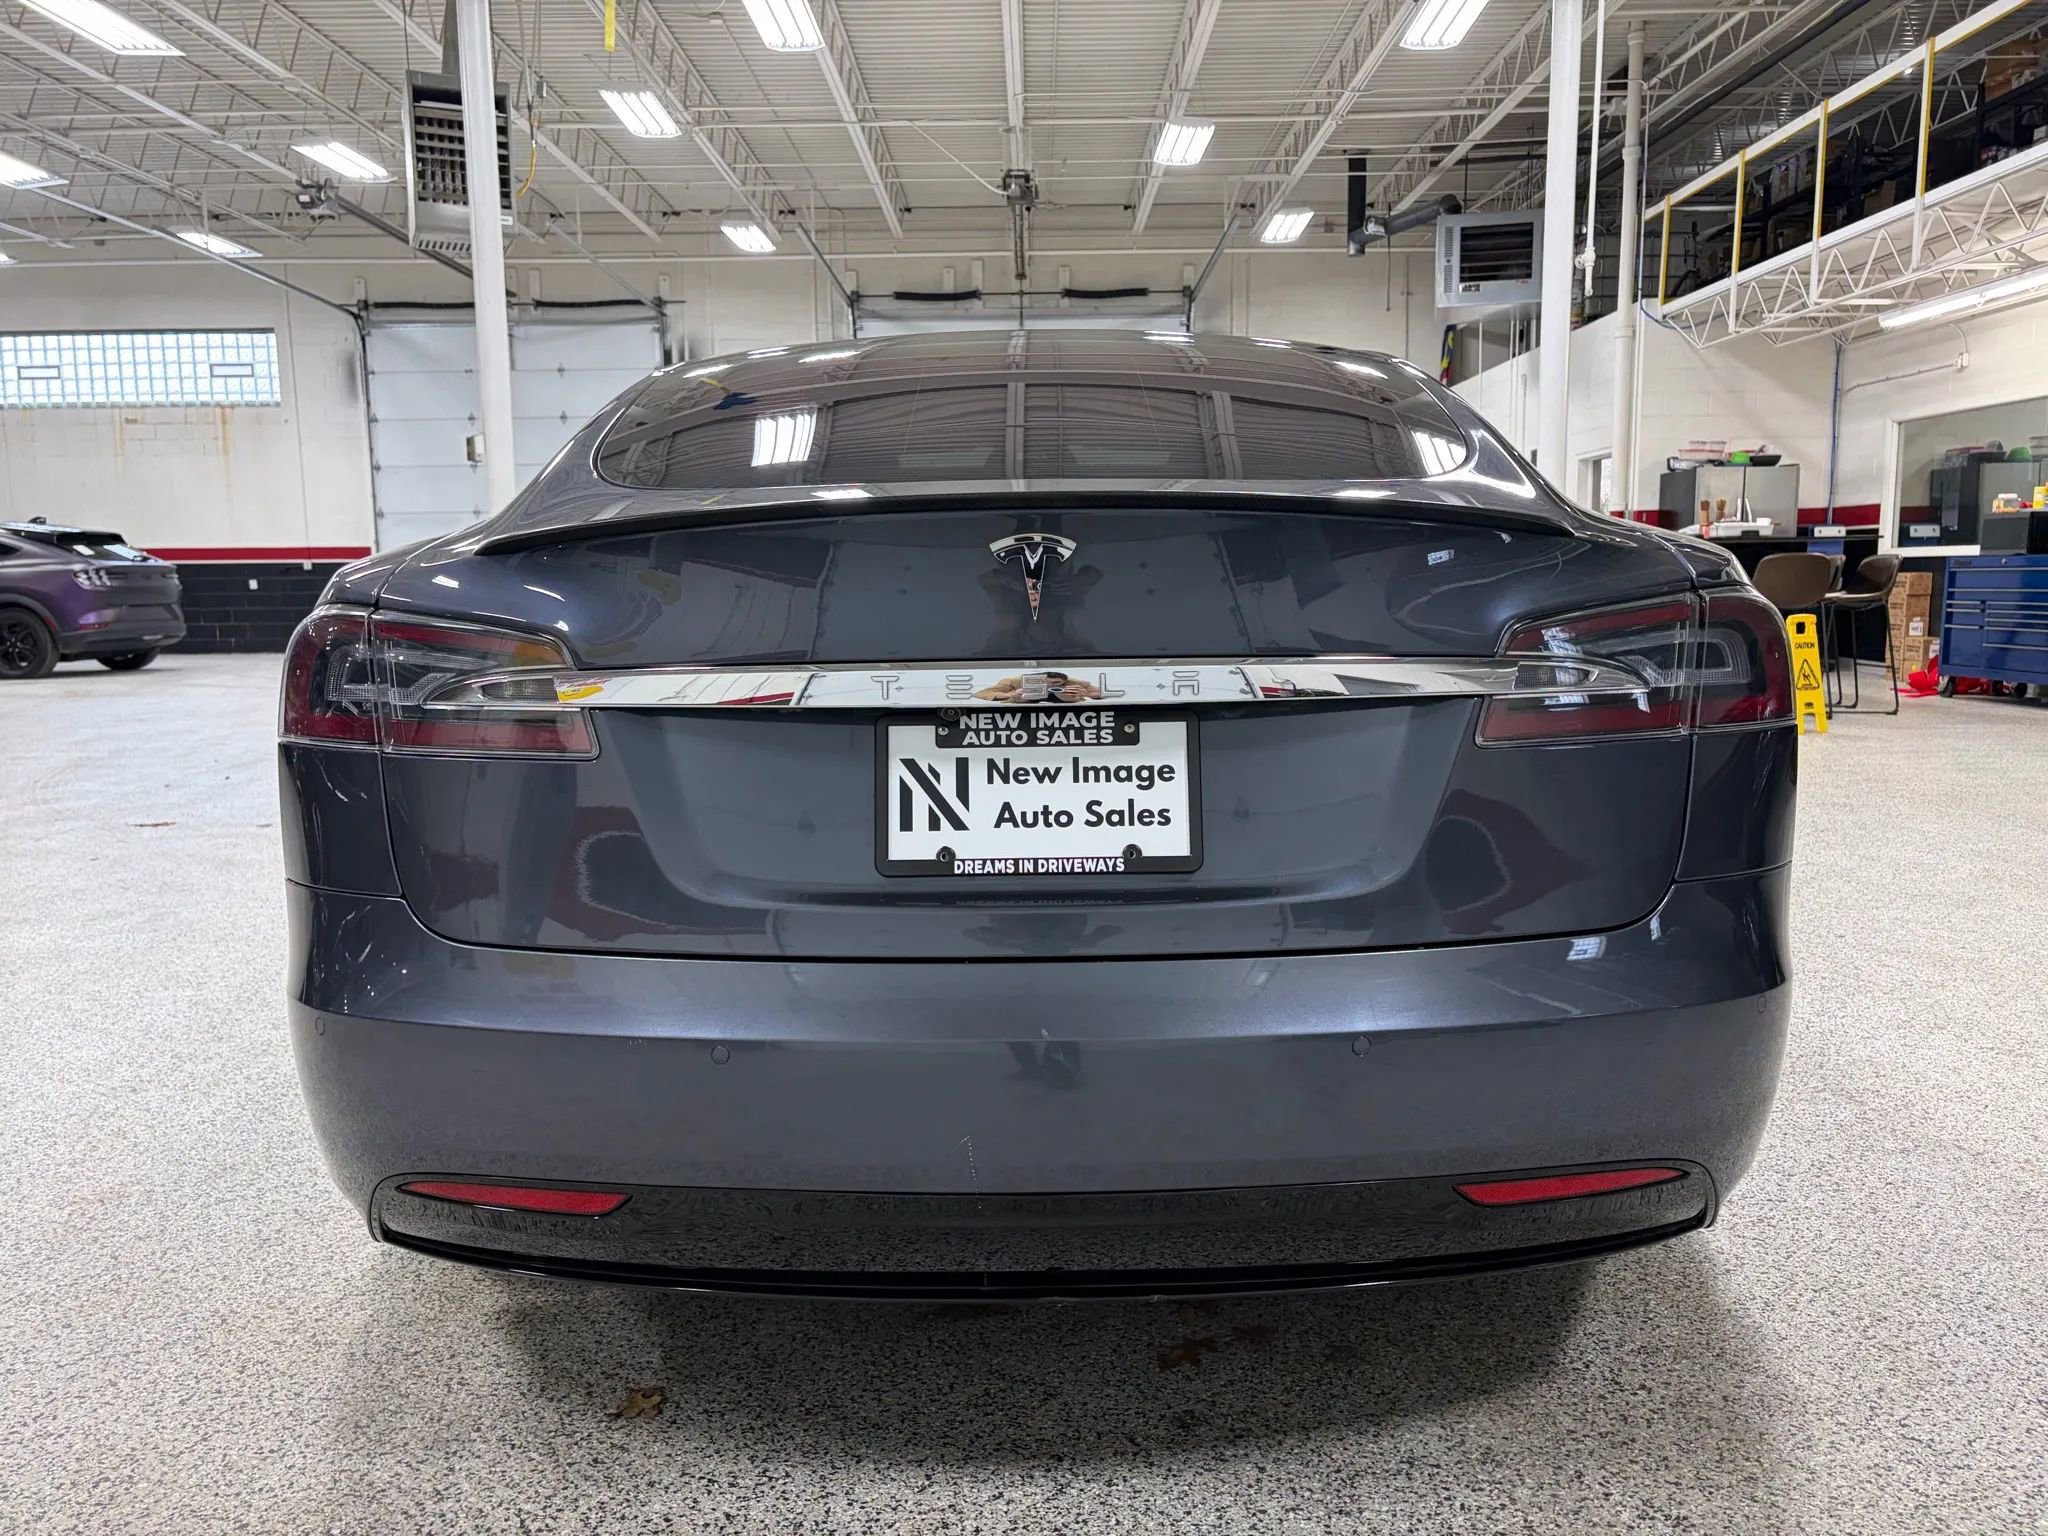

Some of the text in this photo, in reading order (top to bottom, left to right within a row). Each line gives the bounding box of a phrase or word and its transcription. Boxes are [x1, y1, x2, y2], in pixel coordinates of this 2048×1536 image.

[1794, 641, 1815, 649] CAUTION
[870, 670, 1200, 700] TESLA
[959, 711, 1116, 729] NEW IMAGE
[961, 729, 1114, 746] AUTO SALES
[986, 756, 1176, 791] New Image
[993, 798, 1172, 829] Auto Sales
[953, 858, 1125, 875] DREAMS IN DRIVEWAYS
